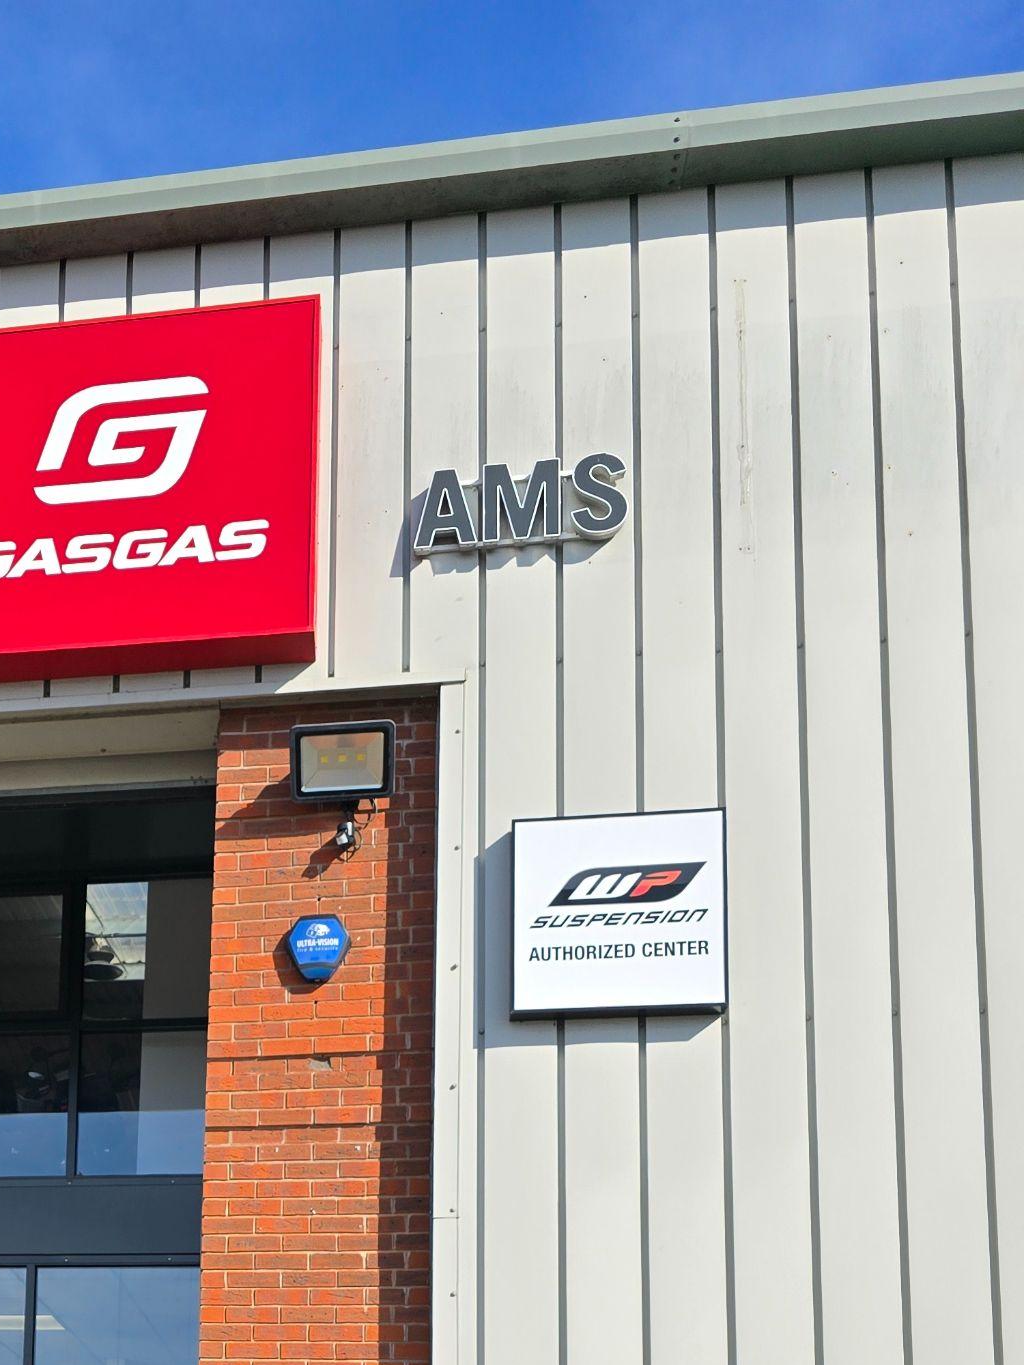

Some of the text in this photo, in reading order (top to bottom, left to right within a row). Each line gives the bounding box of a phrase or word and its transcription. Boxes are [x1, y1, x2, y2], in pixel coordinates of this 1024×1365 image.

[413, 452, 628, 549] AMS
[567, 869, 682, 901] WP
[529, 908, 709, 929] SUSPENSION
[296, 938, 339, 948] ULTRA-VISION
[528, 940, 709, 962] AUTHORIZED CENTER
